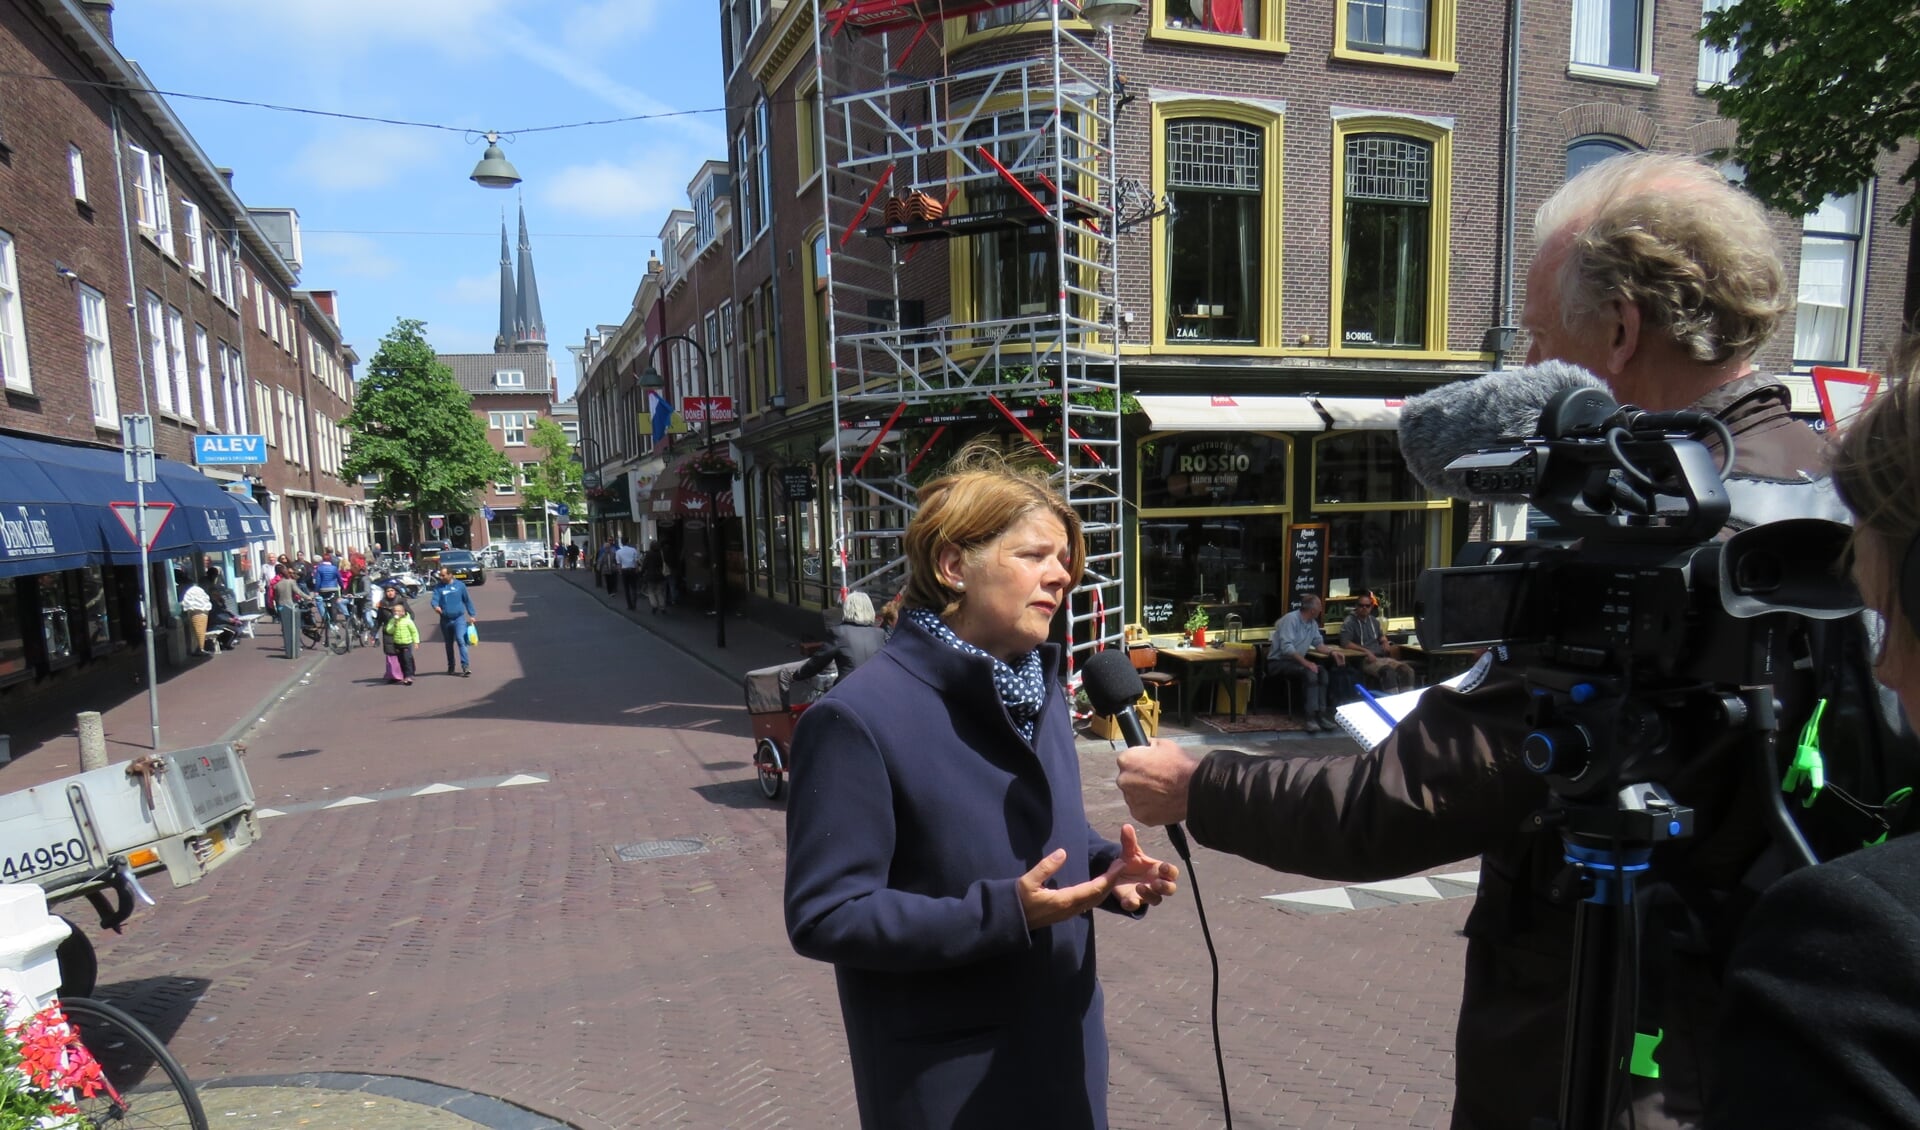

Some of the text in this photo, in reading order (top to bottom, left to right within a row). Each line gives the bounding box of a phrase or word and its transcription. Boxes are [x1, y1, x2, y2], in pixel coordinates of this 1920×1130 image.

[1177, 328, 1198, 337] ZAAL
[1346, 331, 1373, 341] BORREL
[203, 438, 257, 452] ALEV
[1181, 454, 1250, 472] ROSSIO
[0, 838, 86, 882] 44950
